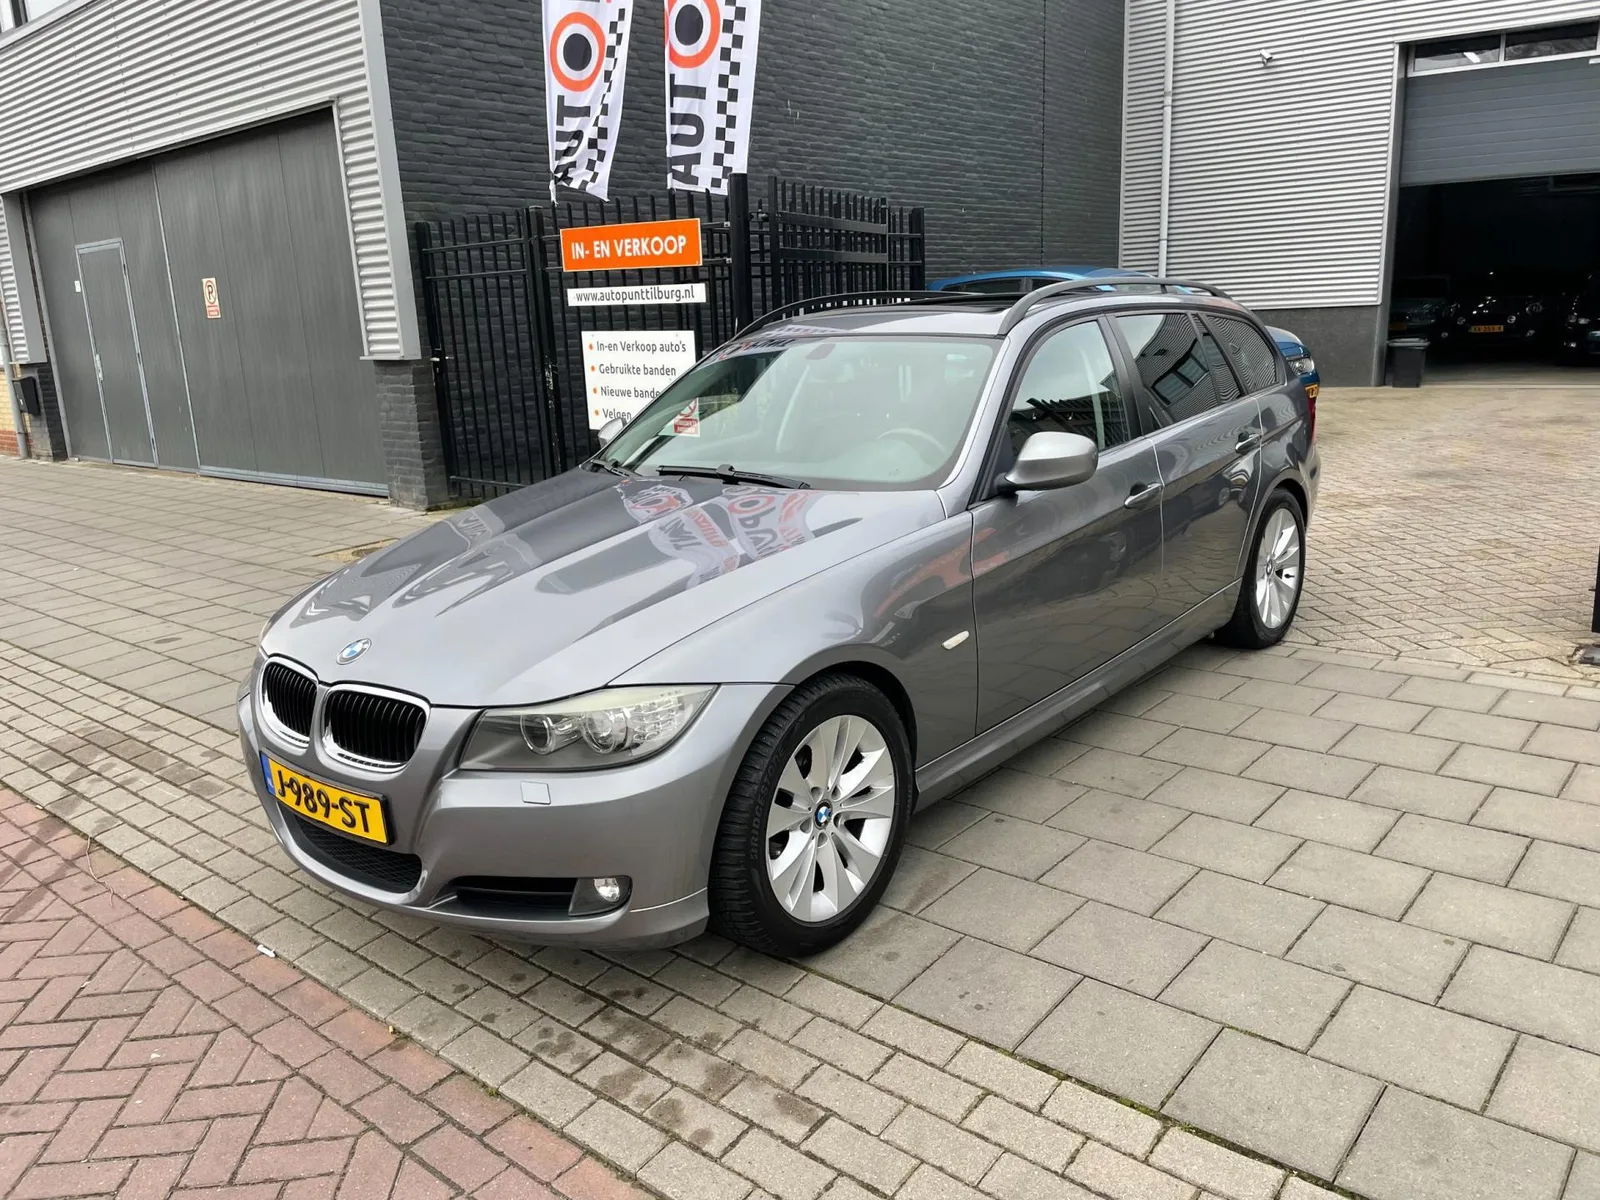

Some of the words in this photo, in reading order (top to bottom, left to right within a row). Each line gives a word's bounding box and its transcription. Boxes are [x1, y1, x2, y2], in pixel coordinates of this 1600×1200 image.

[571, 241, 590, 260] IN-
[593, 239, 611, 259] EN
[613, 234, 687, 258] VERKOOP
[575, 285, 695, 303] www.autopunttilburg.nl
[596, 340, 619, 352] In-en
[619, 340, 657, 354] Verkoop
[659, 340, 687, 353] auto's
[598, 363, 641, 375] Gebruikte
[643, 364, 677, 376] banden
[600, 386, 632, 398] Nieuwe
[633, 386, 660, 399] bande
[276, 769, 370, 833] J-989-ST
